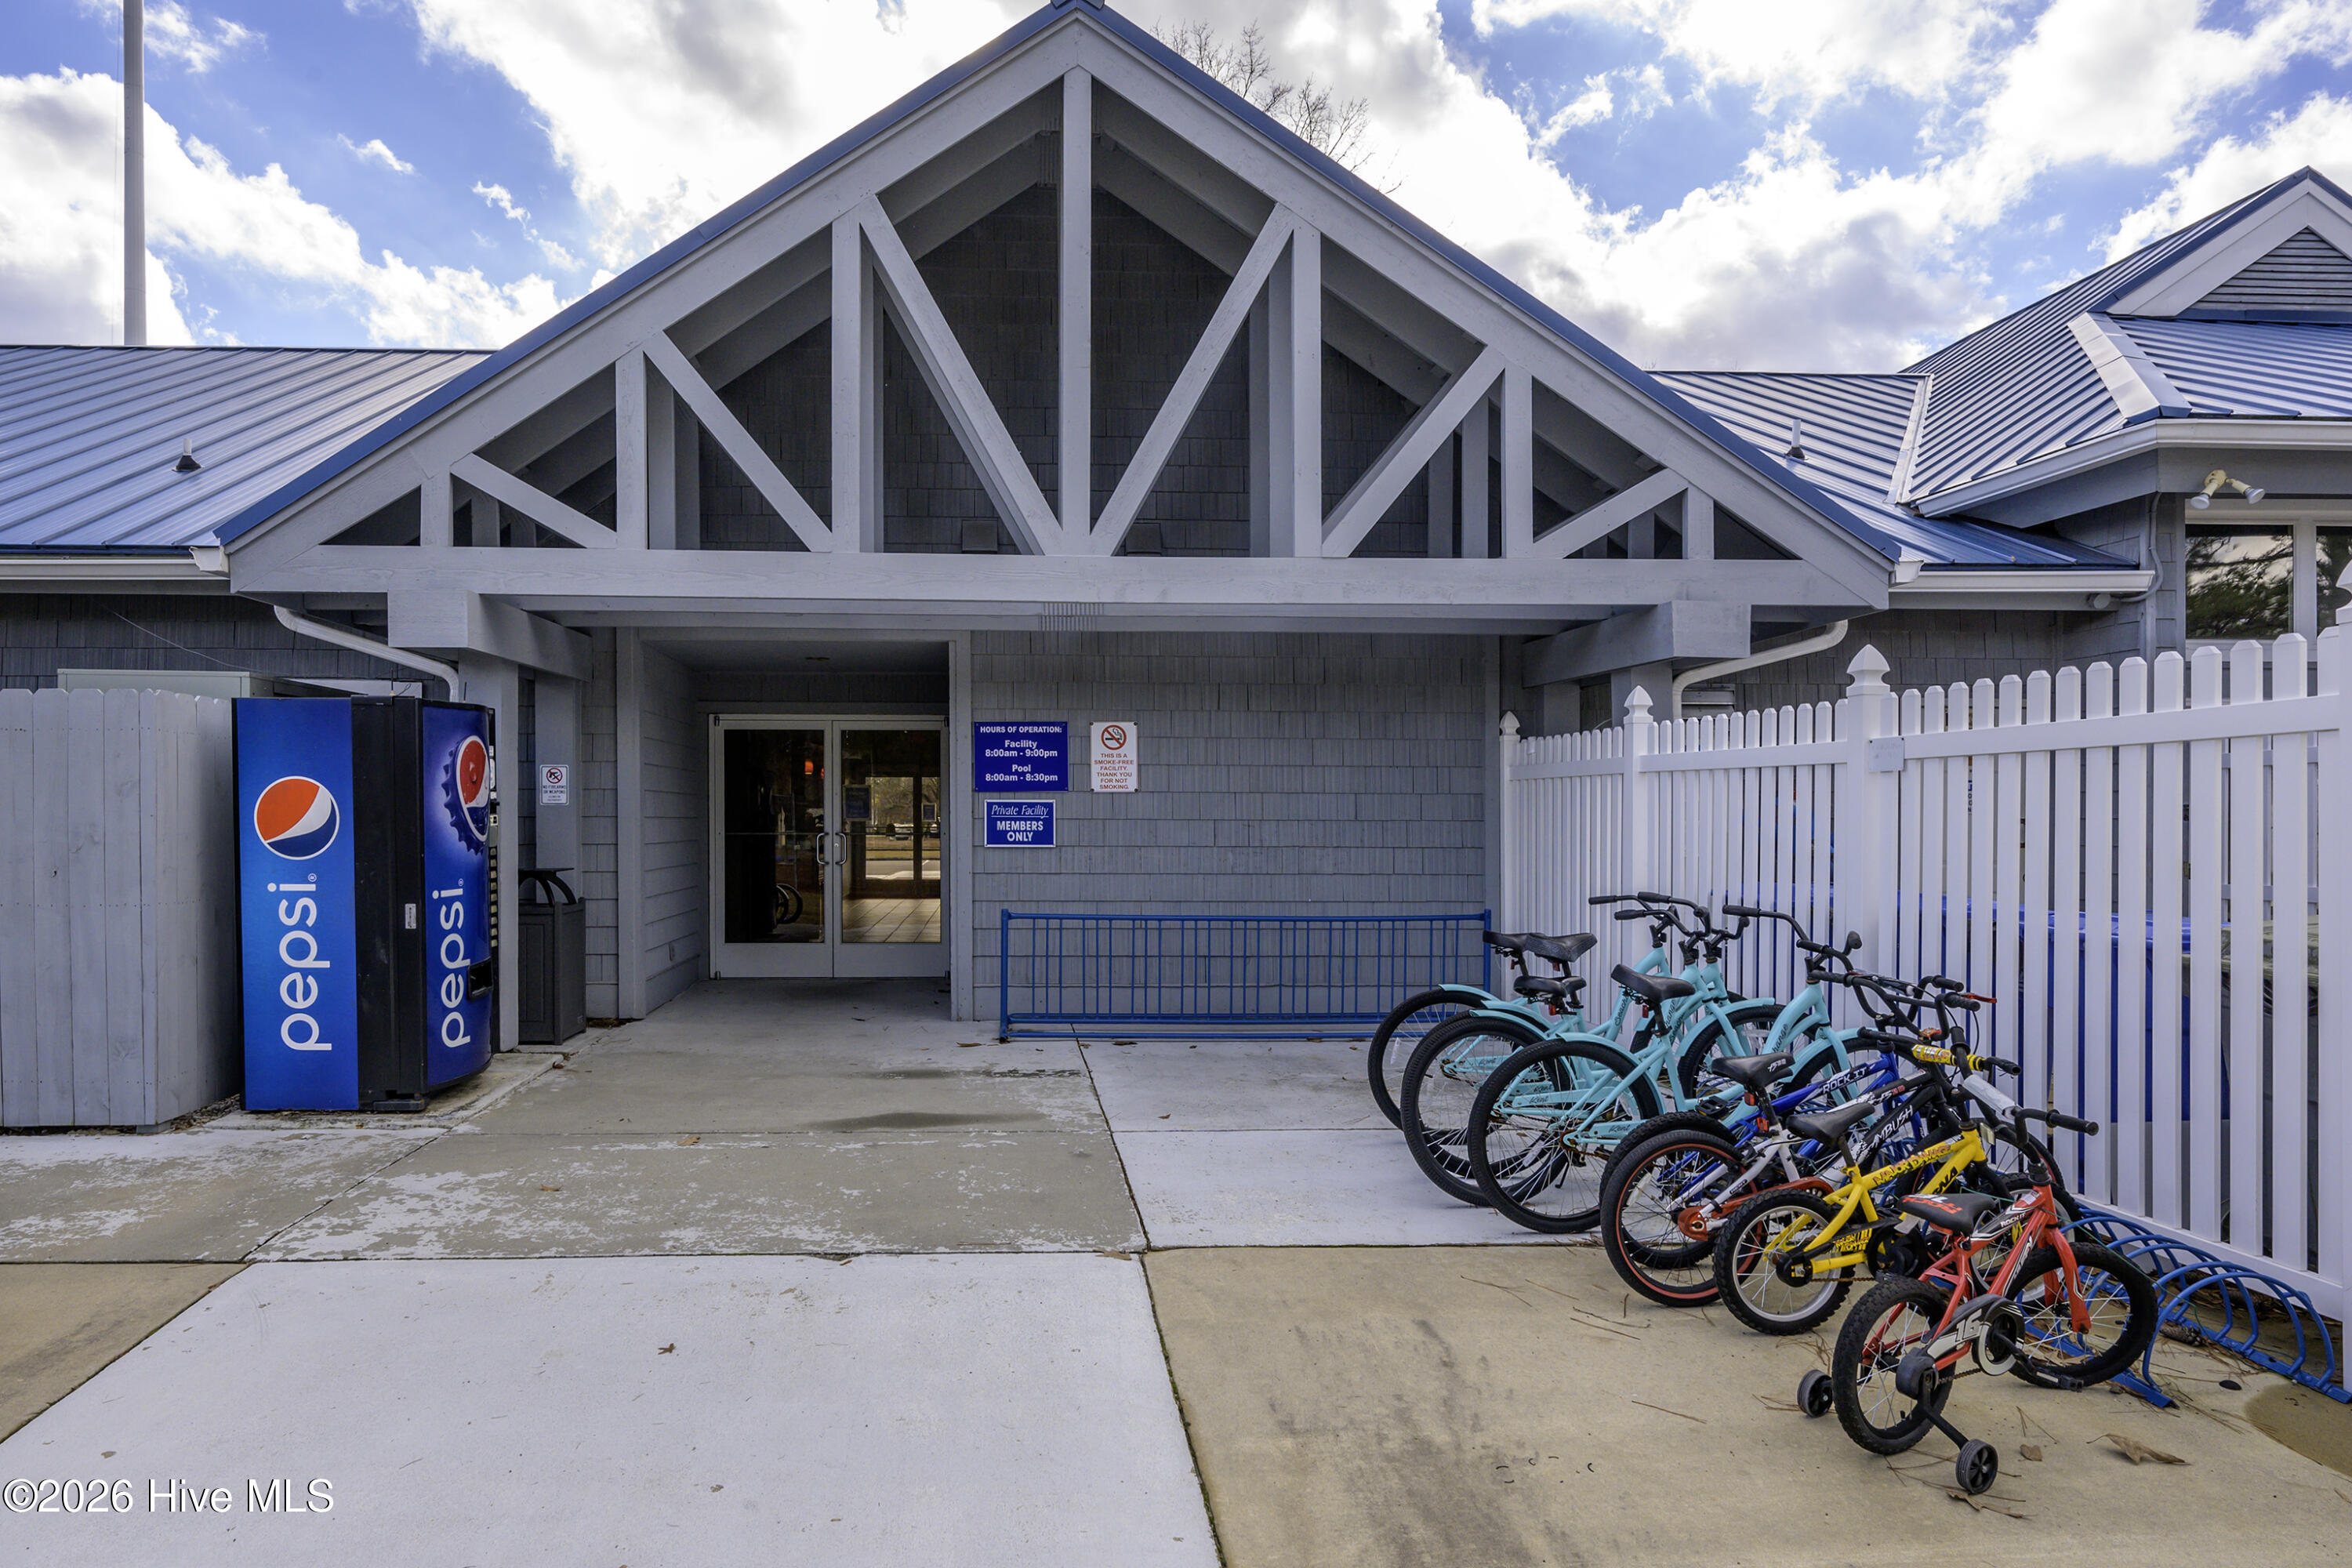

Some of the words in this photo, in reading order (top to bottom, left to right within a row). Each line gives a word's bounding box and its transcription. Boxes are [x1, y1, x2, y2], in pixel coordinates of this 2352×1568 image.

[1004, 740, 1037, 749] Facility
[1025, 750, 1058, 758] 9:00pm
[1025, 774, 1058, 782] 8:30pm
[991, 804, 1018, 815] Private
[1021, 804, 1049, 818] Facility
[996, 821, 1044, 831] MEMBERS
[1007, 832, 1033, 841] ONLY
[267, 882, 332, 1051] pepsi
[432, 887, 471, 1048] pepsi
[1822, 1075, 1851, 1094] ROCK
[1851, 1067, 1867, 1080] IT
[1608, 1123, 1631, 1134] Kent
[1864, 1104, 1913, 1151] AMBUSH
[1955, 1308, 1983, 1342] 16
